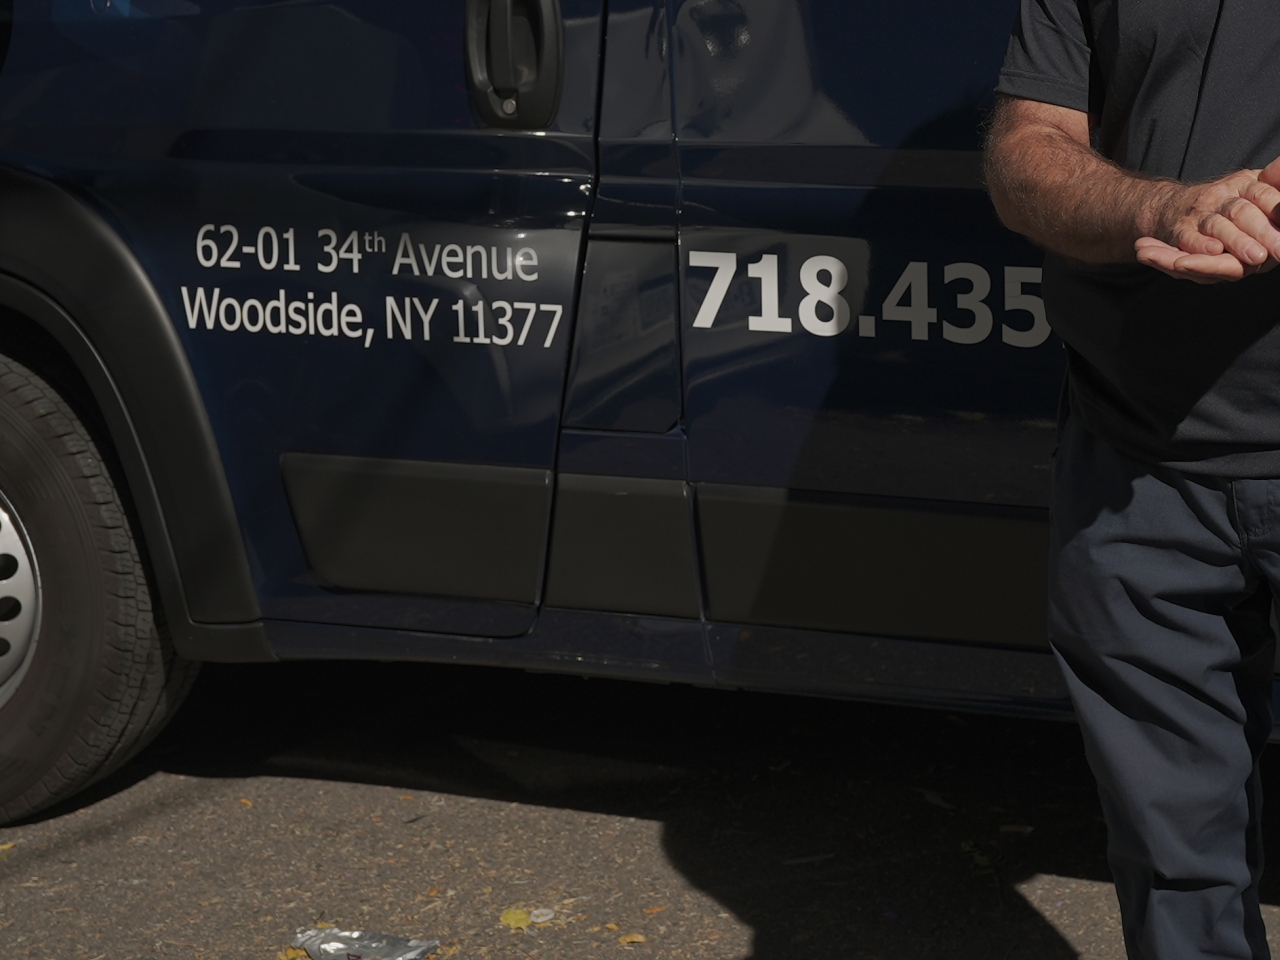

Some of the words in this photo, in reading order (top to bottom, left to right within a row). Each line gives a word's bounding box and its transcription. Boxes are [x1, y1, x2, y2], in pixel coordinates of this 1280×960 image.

[195, 223, 301, 272] 62-01
[316, 228, 386, 274] 34th
[391, 232, 540, 282] Avenue
[180, 285, 375, 348] Woodside,
[384, 295, 440, 341] NY
[451, 298, 563, 349] 11377
